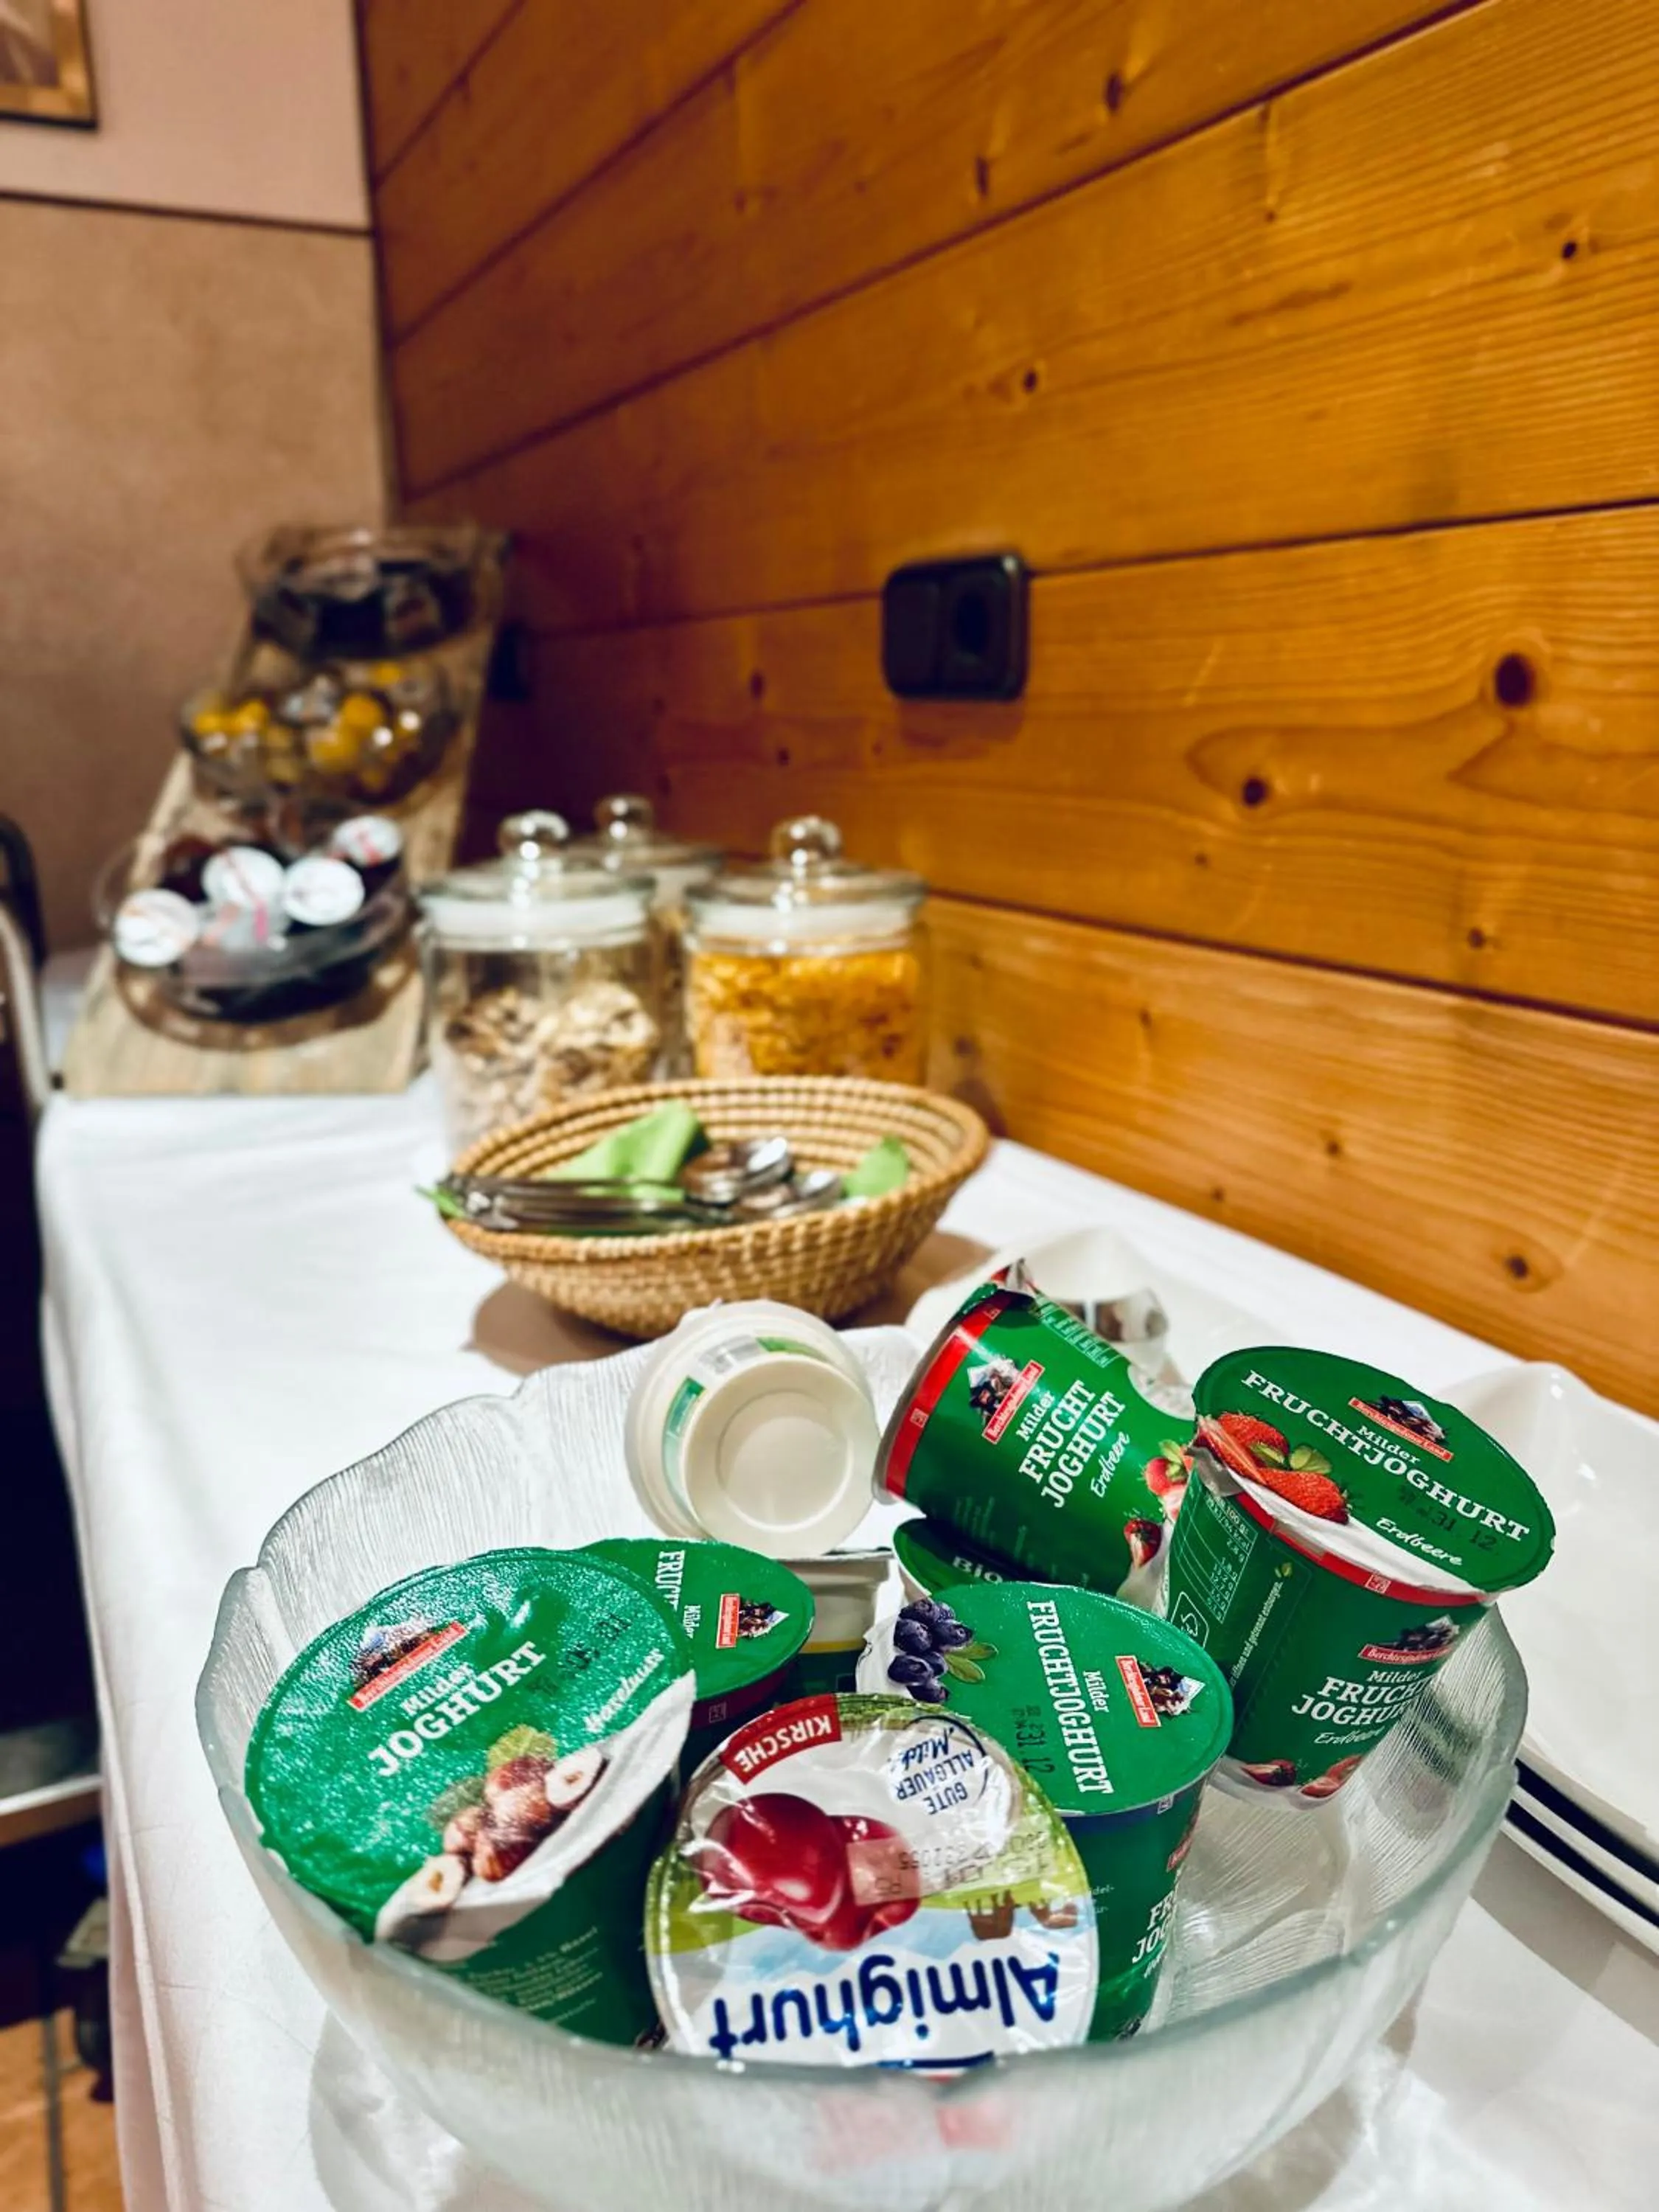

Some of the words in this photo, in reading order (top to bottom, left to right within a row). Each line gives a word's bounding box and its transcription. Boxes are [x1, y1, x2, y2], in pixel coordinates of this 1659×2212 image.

[1016, 1391, 1055, 1441] Milder
[1018, 1380, 1096, 1484] FRUCHT
[1041, 1391, 1125, 1508] JOGHURT
[1356, 1425, 1421, 1464] Milder
[1241, 1369, 1529, 1541] FRUCHTJOGHURT
[1376, 1517, 1463, 1566] Erdbeere
[368, 1641, 546, 1777] JOGHURT
[401, 1662, 473, 1717] Milder
[583, 1647, 664, 1733] Haselnuss
[1026, 1600, 1114, 1794] FRUCHTJOGHURT
[1082, 1670, 1110, 1712] Milder
[734, 1714, 832, 1773] KIRSCHE
[923, 1781, 967, 1815] GUTE
[709, 1952, 1061, 2059] Almighurt
